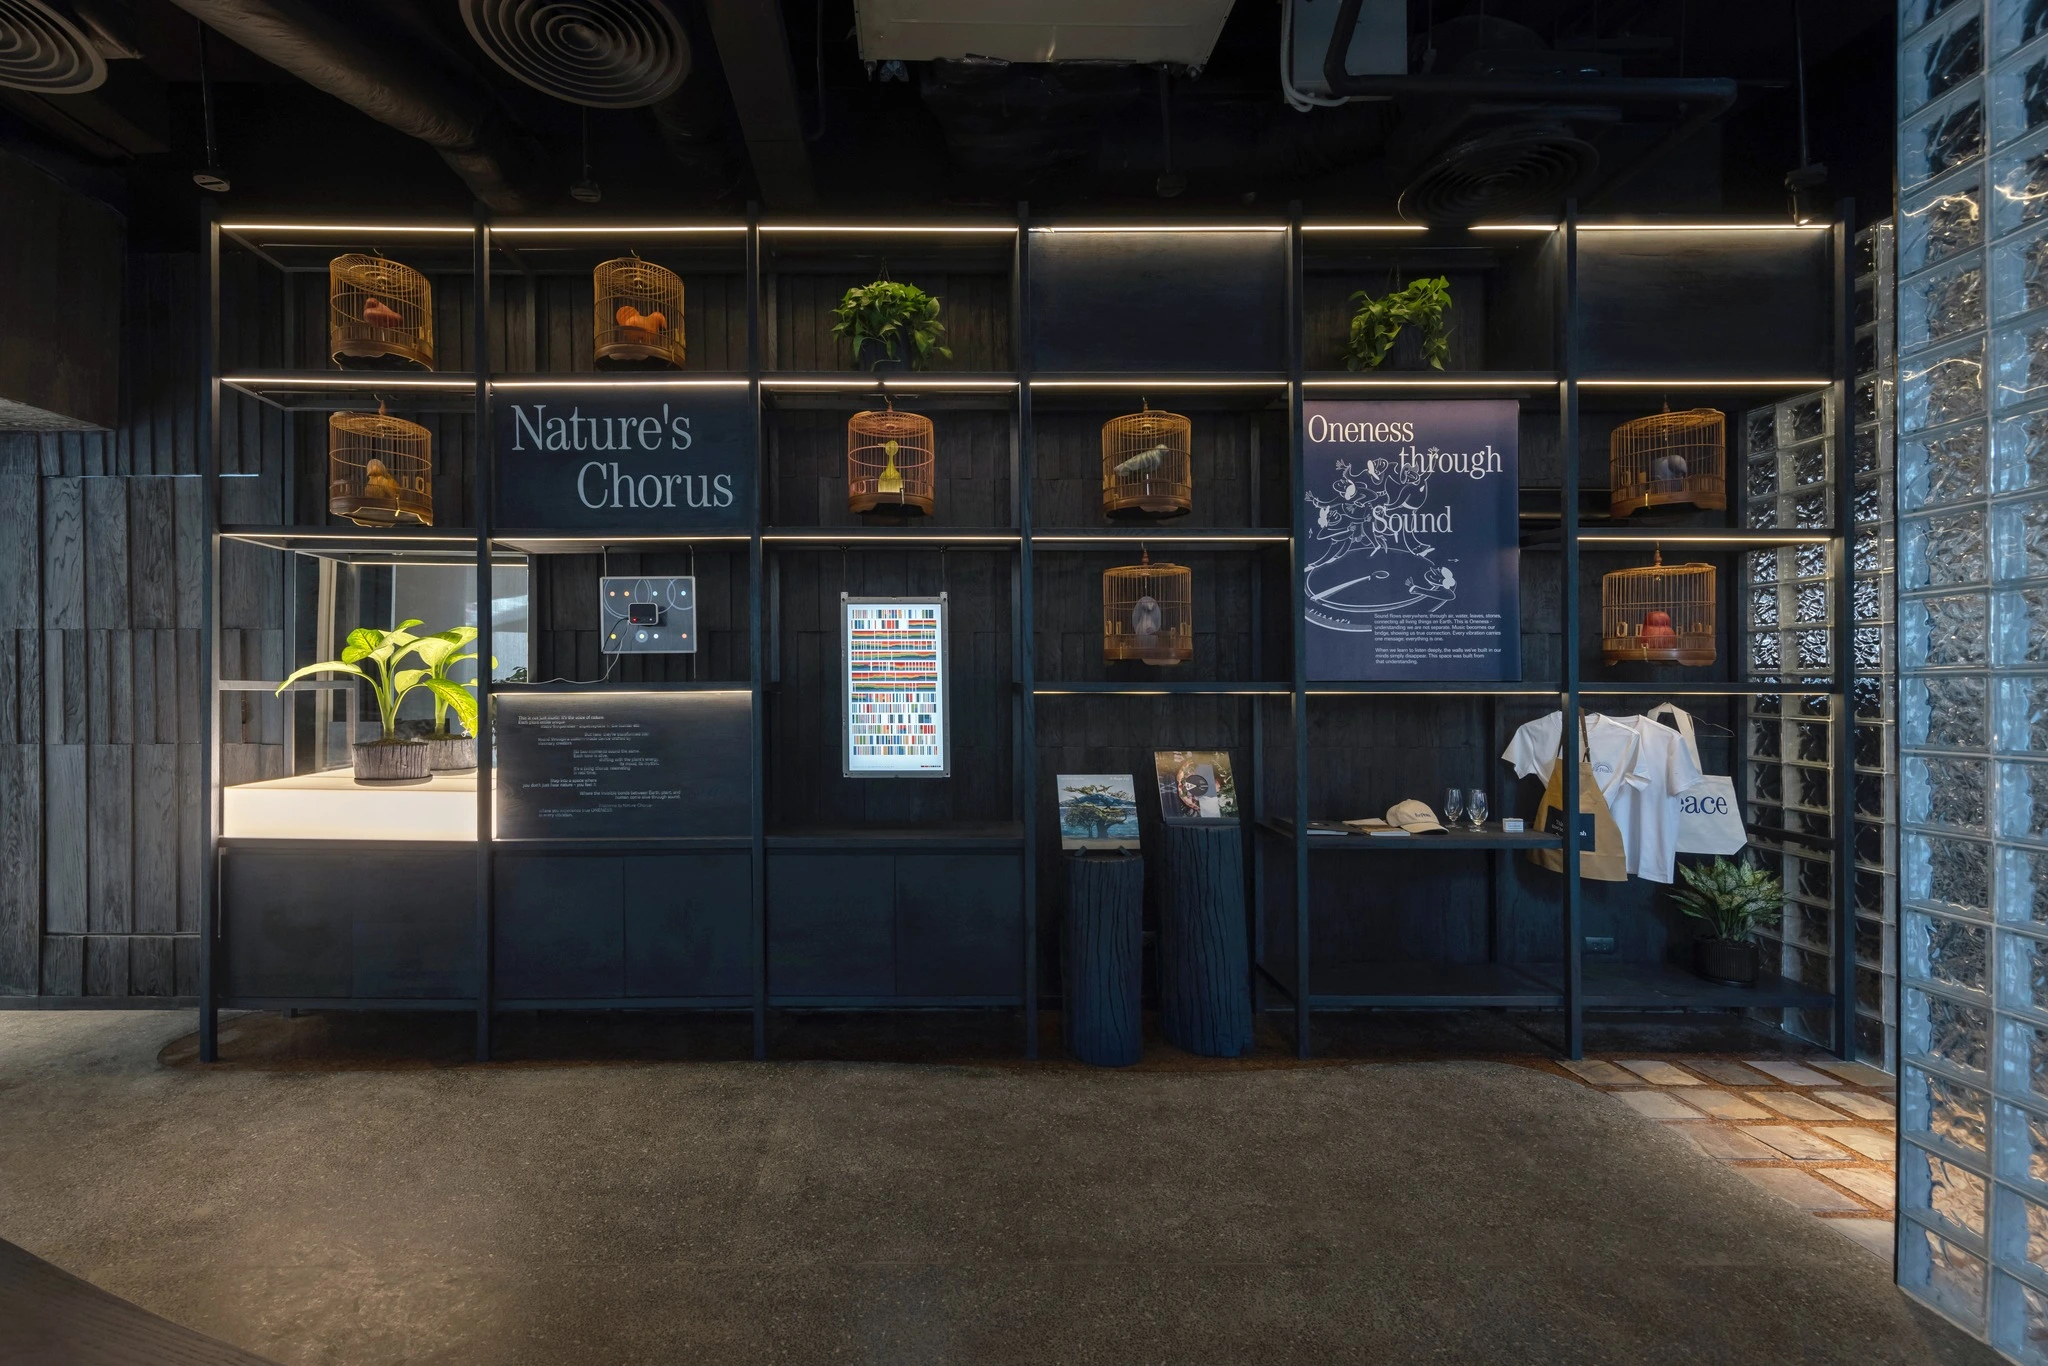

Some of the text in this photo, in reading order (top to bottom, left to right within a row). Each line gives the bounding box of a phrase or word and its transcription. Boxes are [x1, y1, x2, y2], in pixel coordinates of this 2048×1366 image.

[511, 403, 691, 450] Nature's
[1309, 414, 1415, 442] Oneness
[1399, 445, 1503, 479] through
[577, 461, 733, 508] Chorus
[1372, 506, 1453, 534] Sound
